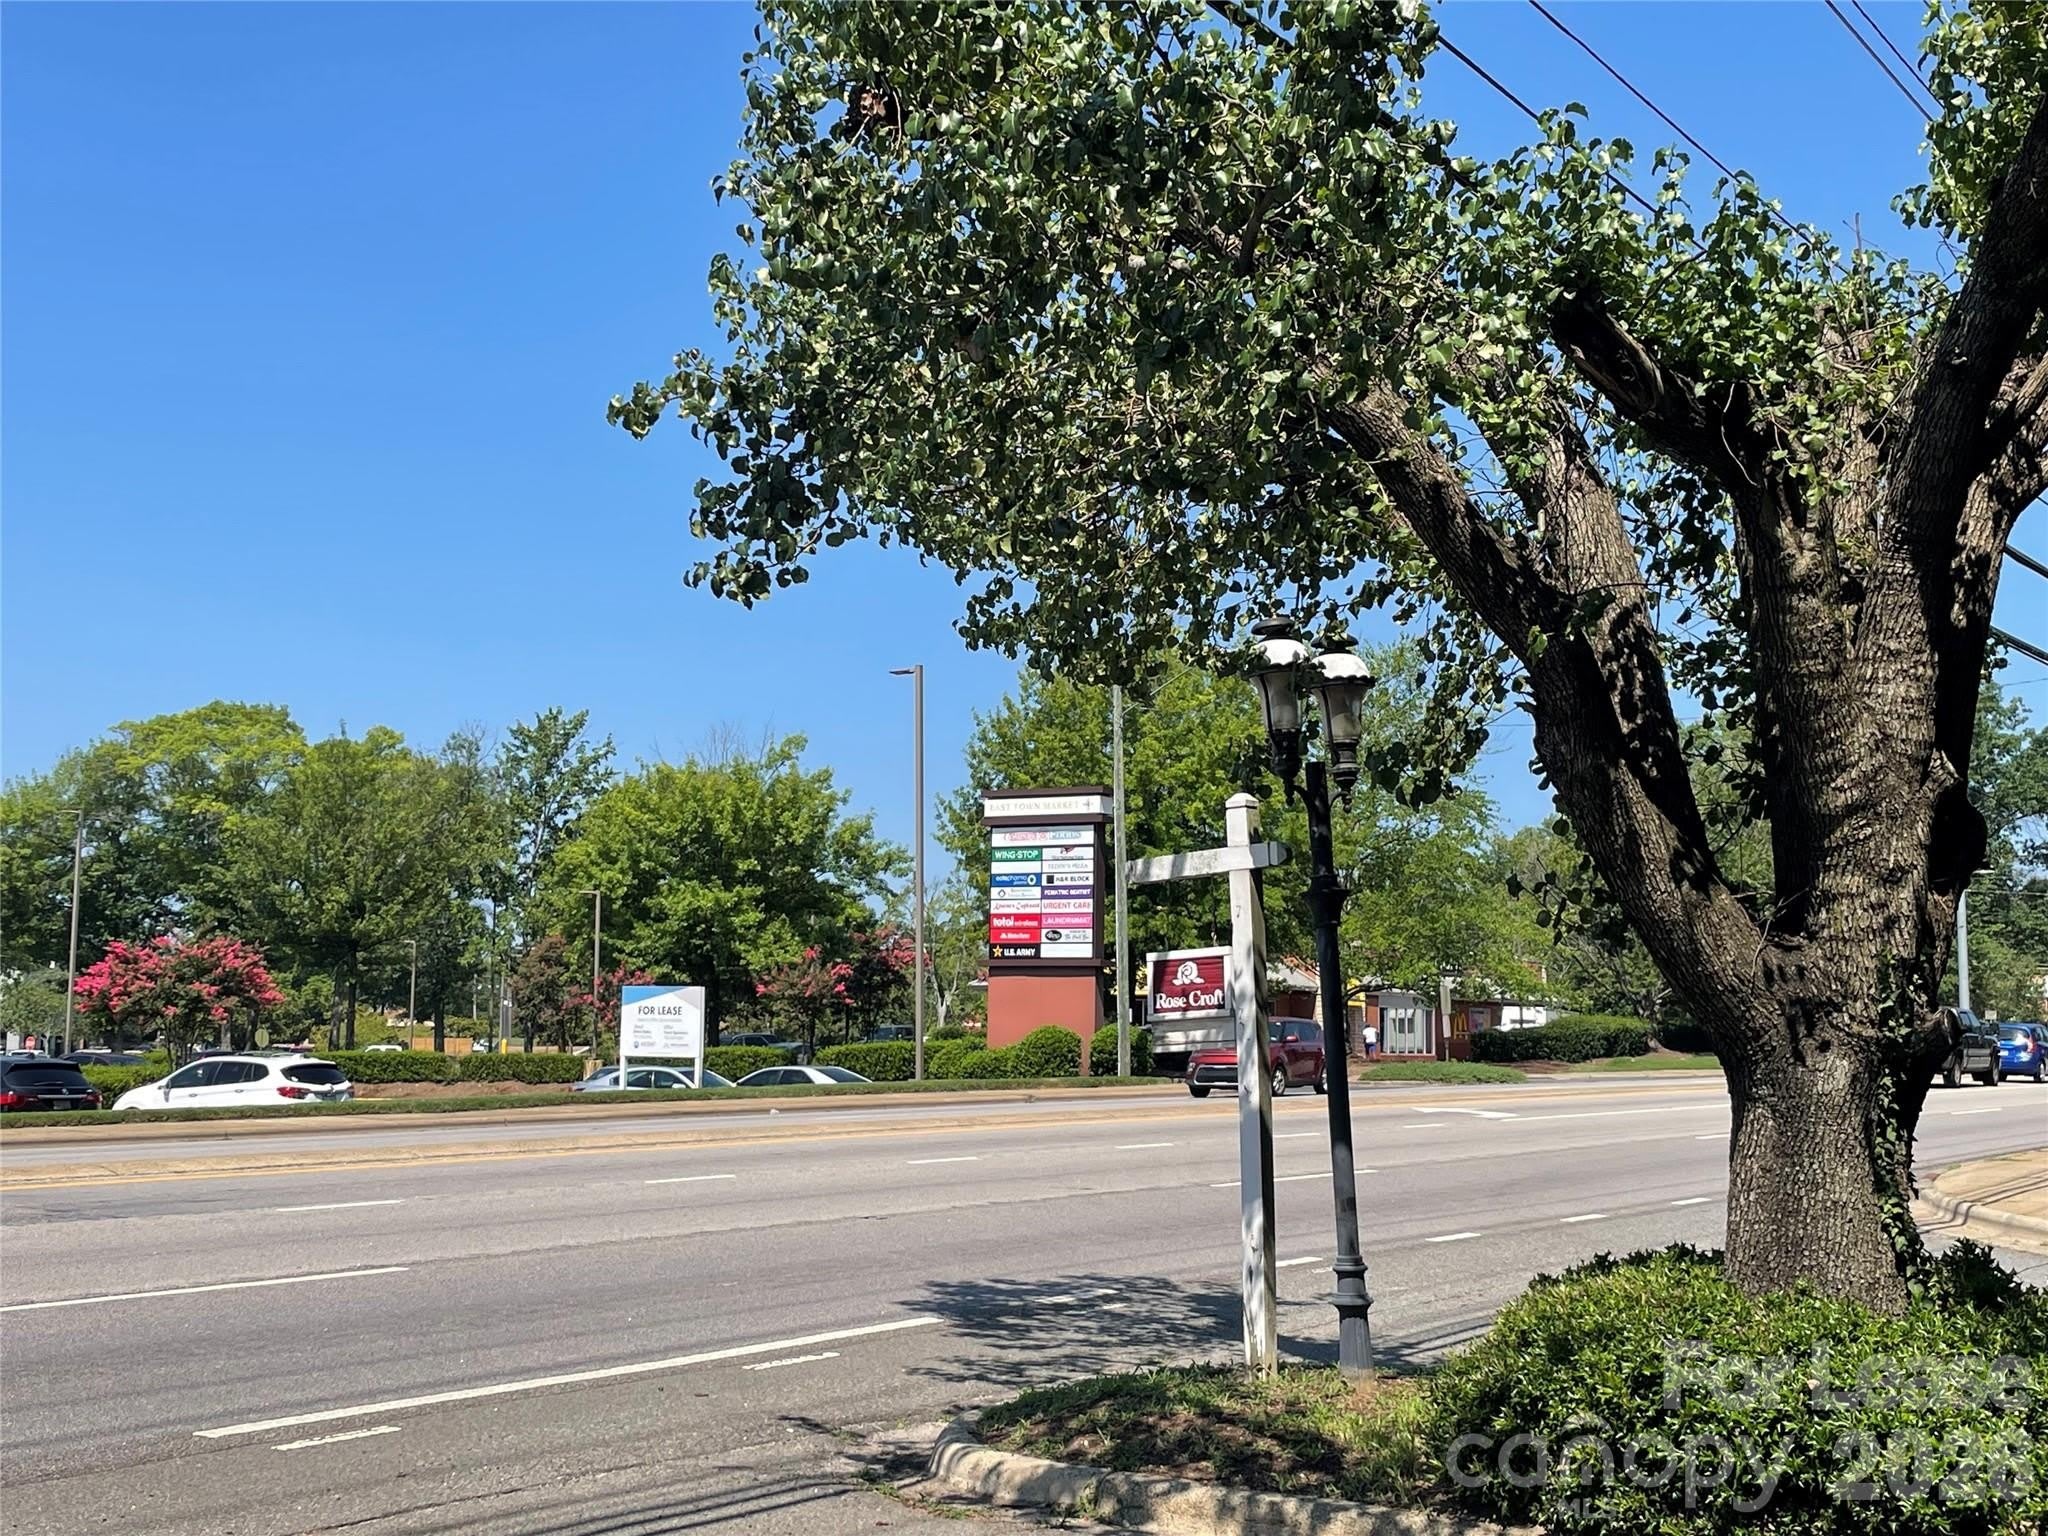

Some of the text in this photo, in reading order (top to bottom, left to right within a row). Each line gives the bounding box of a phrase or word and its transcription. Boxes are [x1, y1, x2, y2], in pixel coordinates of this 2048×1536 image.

[990, 802, 1011, 812] EAST
[1043, 801, 1079, 810] MARKET
[1043, 901, 1091, 910] URGENT CARE
[992, 915, 1014, 927] total
[1016, 947, 1036, 956] ARMY
[1155, 988, 1224, 1009] Rose Croft
[638, 1005, 683, 1016] FOR LEASE
